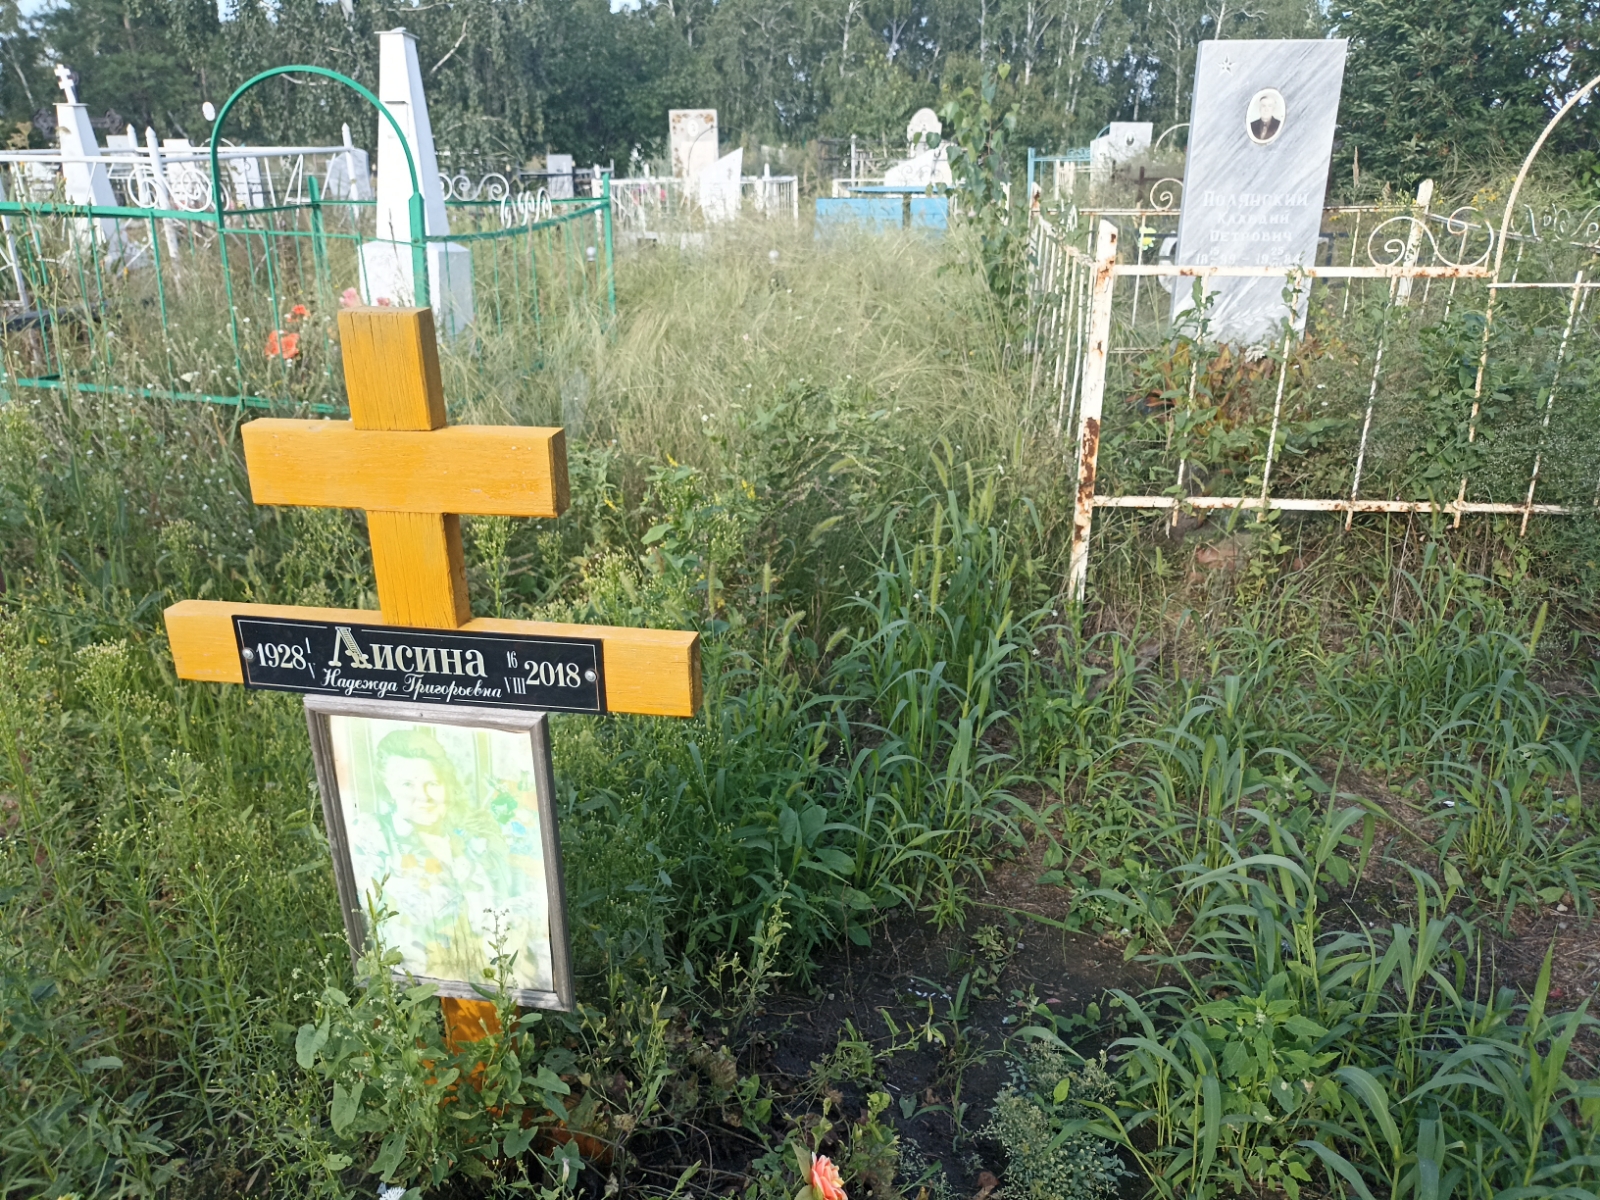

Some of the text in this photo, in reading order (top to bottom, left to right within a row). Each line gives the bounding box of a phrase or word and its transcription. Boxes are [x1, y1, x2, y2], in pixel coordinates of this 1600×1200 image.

[255, 643, 307, 671] 1928
[328, 626, 488, 678] Лисина
[506, 650, 519, 669] 16
[320, 668, 503, 703] Надежда Григорьевна
[524, 660, 582, 689] 2018
